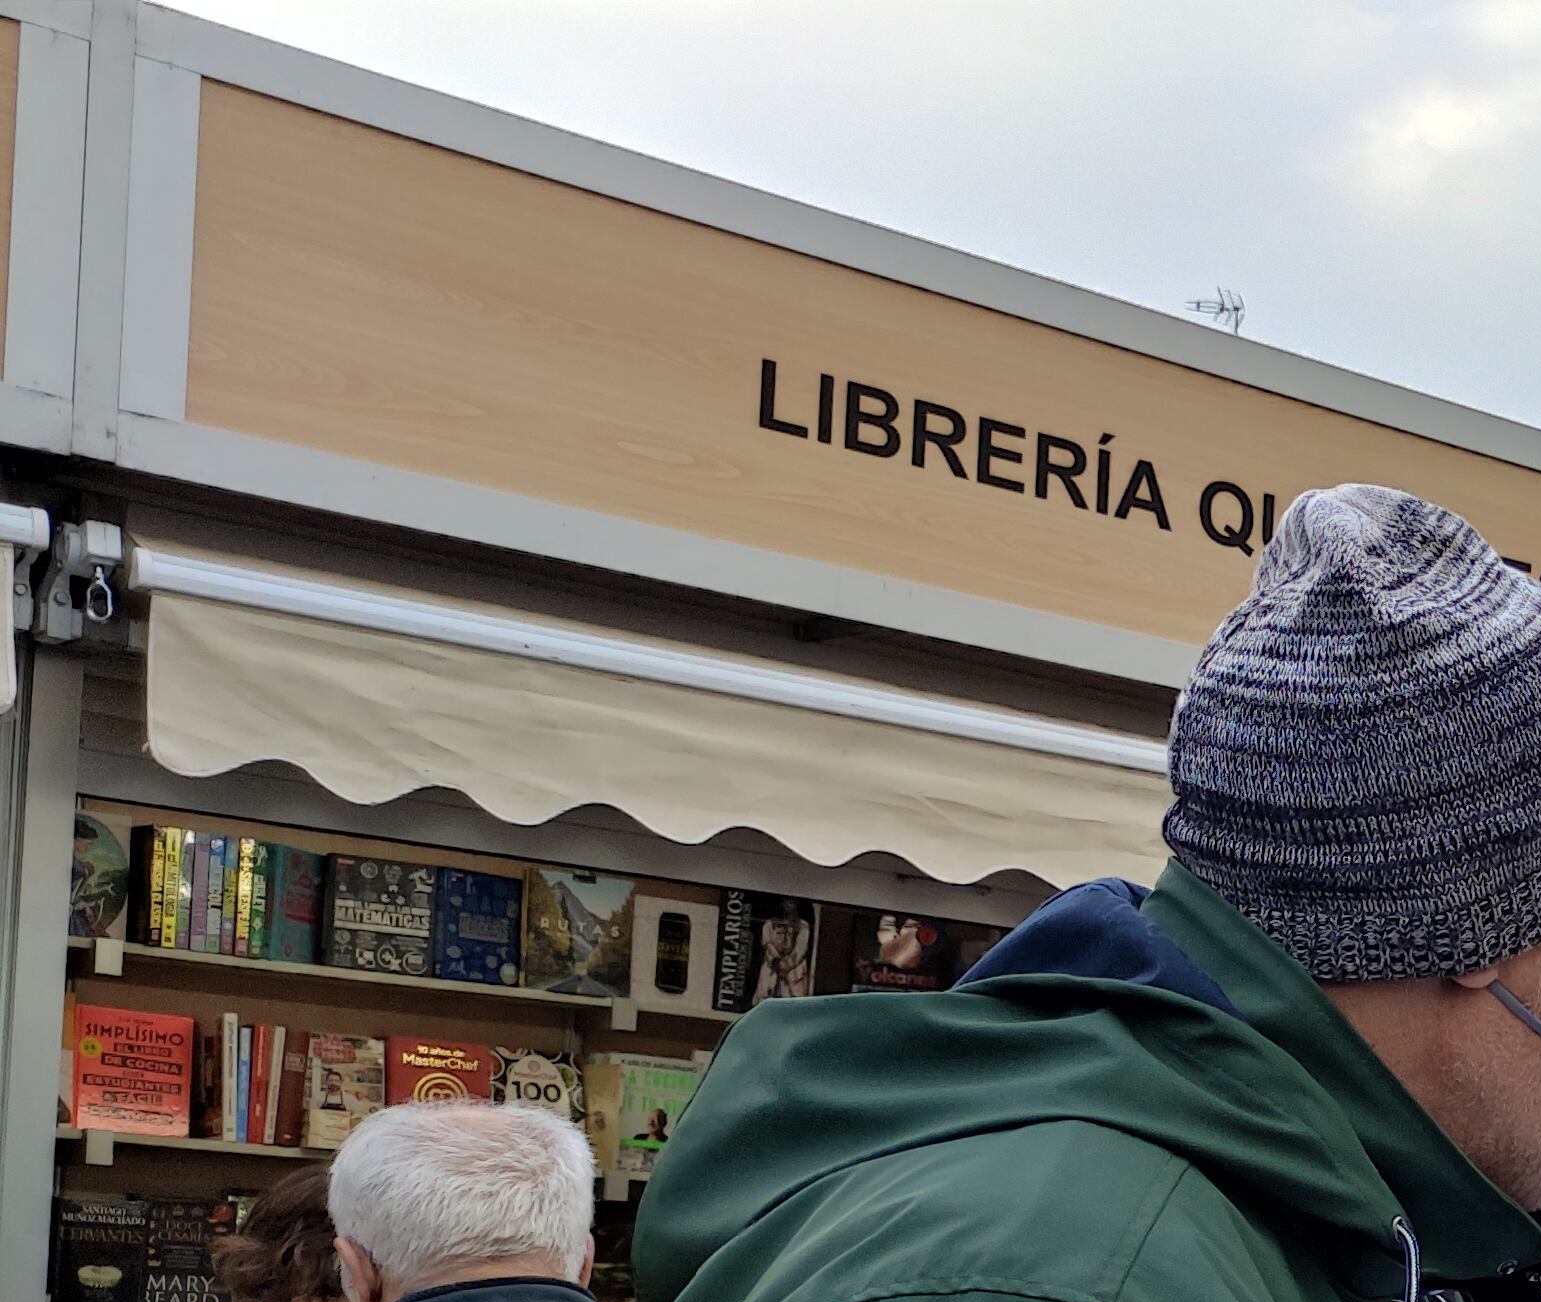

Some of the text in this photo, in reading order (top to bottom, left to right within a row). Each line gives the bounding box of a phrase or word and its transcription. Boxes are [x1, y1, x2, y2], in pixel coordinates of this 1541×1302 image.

[758, 359, 1173, 532] LIBRERÍA
[539, 916, 621, 939] RUTAS
[717, 890, 745, 1009] TEMPLARIOS
[85, 1023, 184, 1046] SIMPLÍSIMO
[126, 1058, 179, 1075] COCINA
[402, 1052, 480, 1072] MasterChef
[511, 1081, 562, 1103] 100
[61, 1226, 144, 1244] CERVANTES
[147, 1273, 216, 1293] MARY
